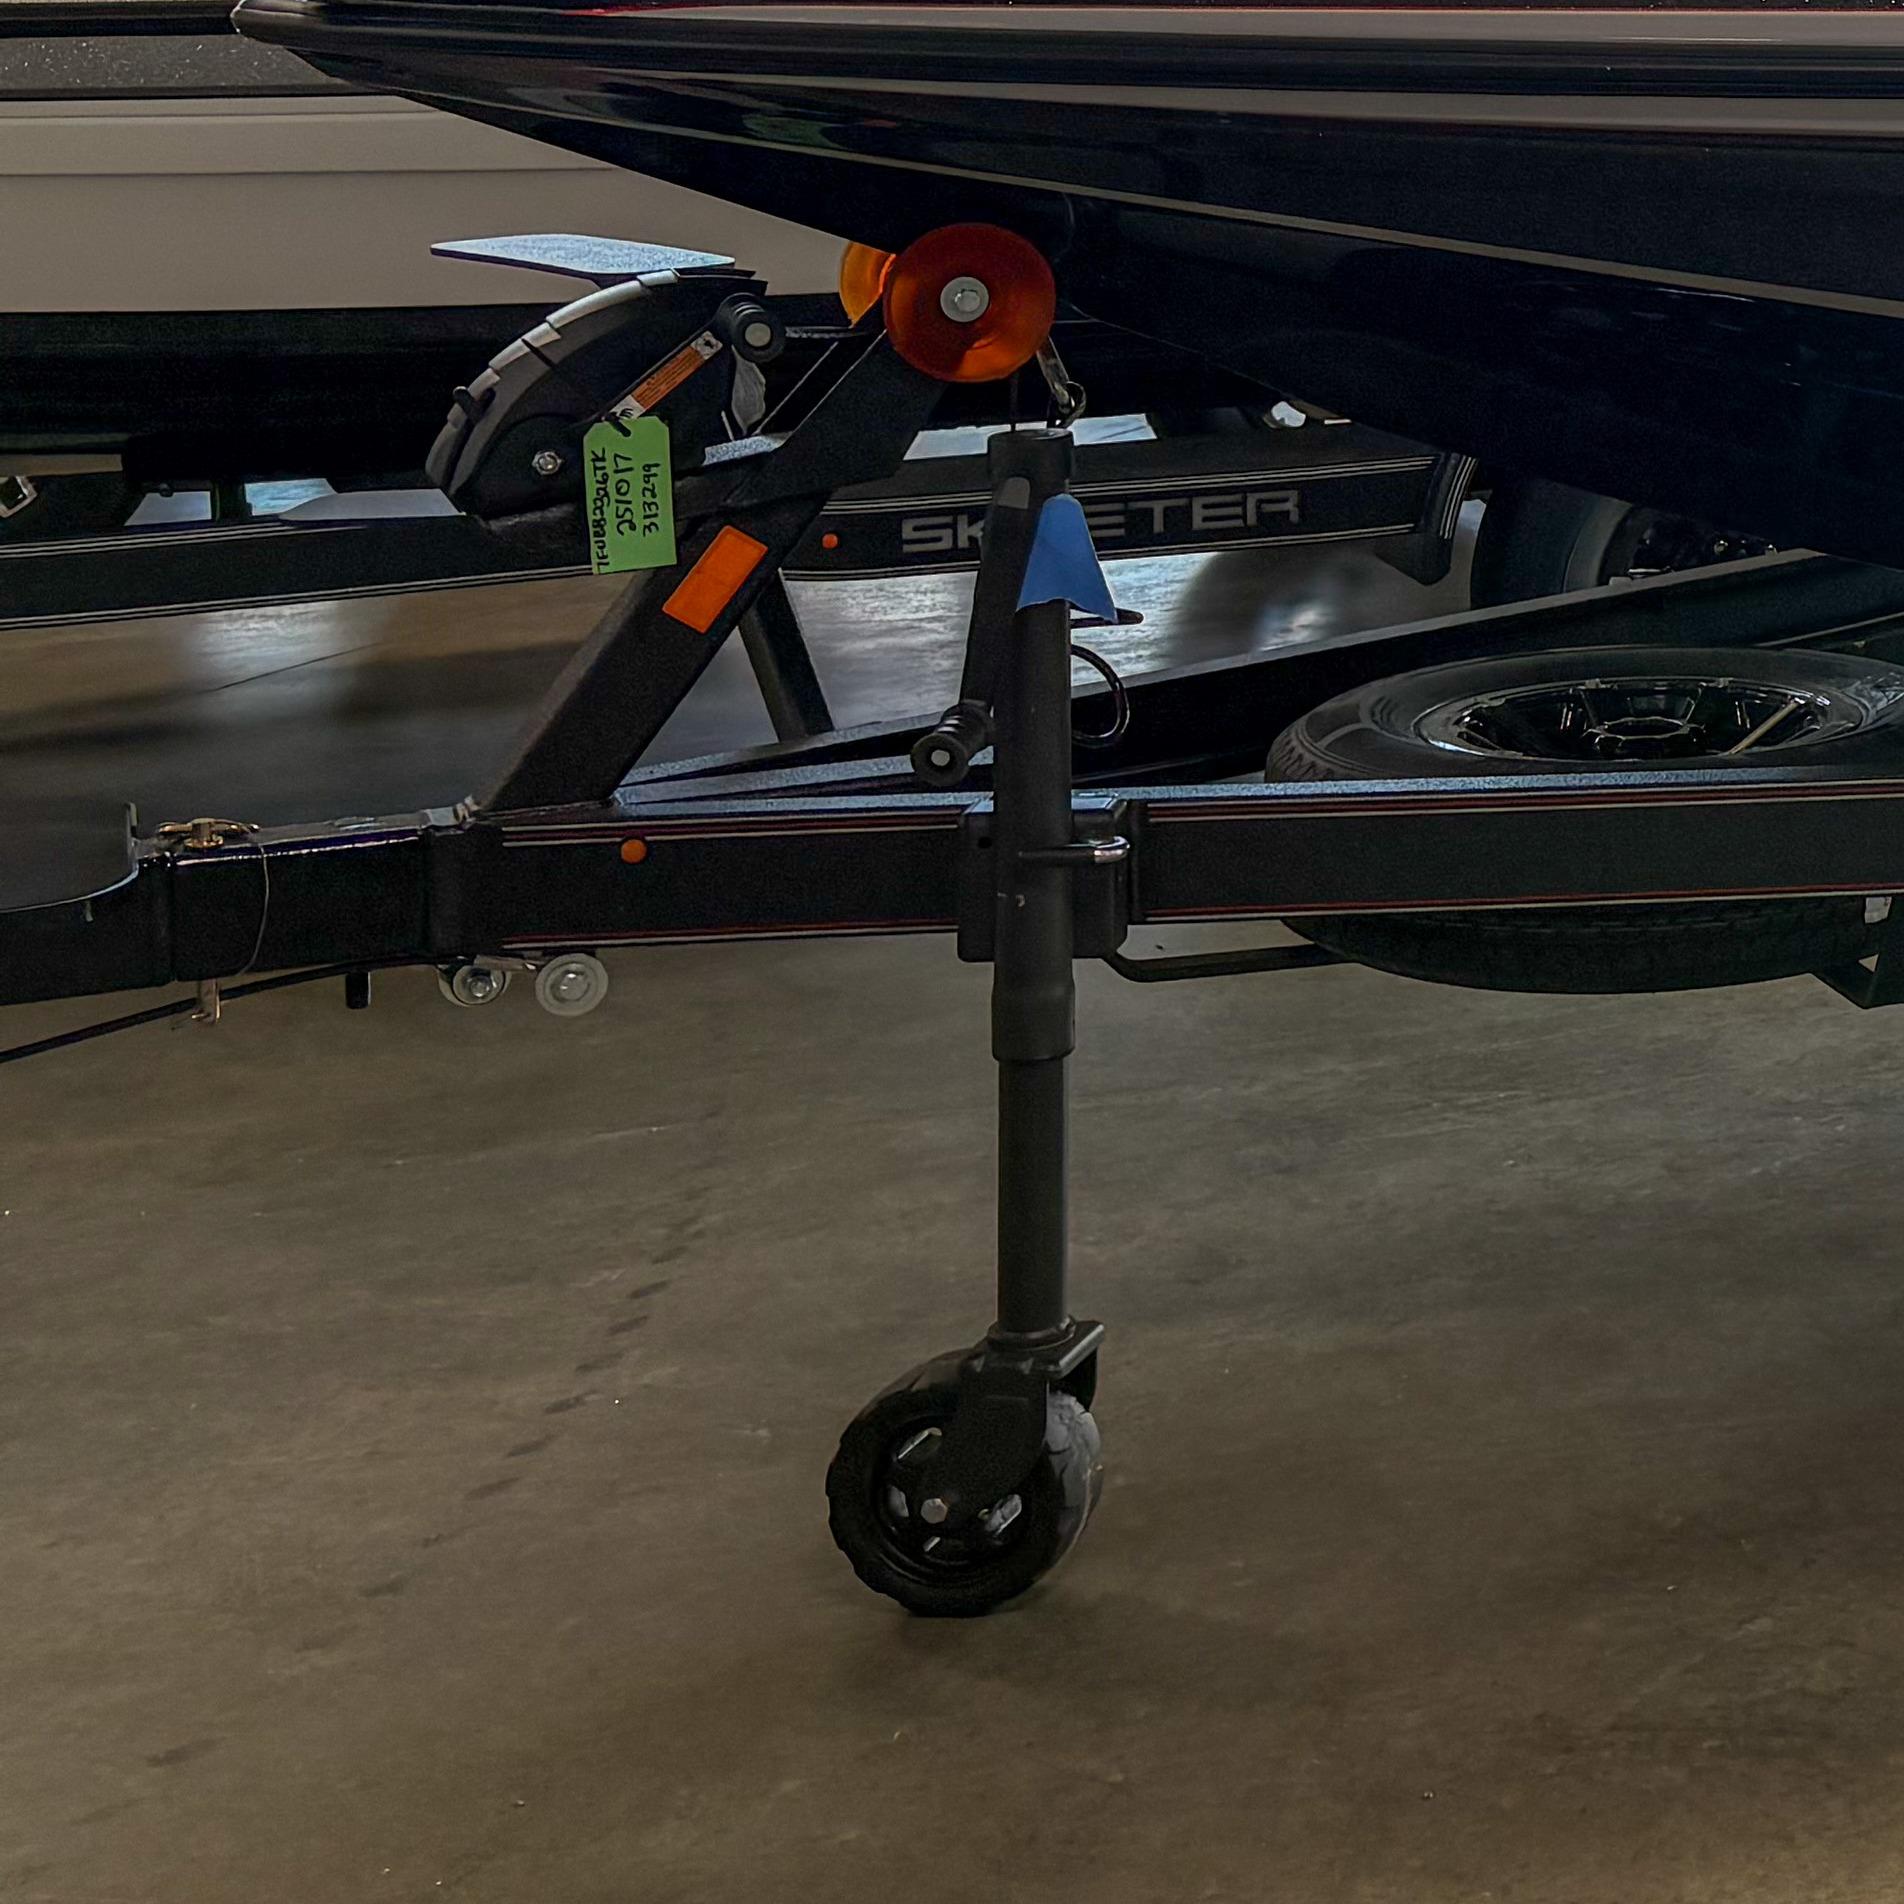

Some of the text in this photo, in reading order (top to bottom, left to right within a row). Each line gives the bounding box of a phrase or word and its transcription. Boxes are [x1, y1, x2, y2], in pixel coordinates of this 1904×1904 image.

[613, 452, 638, 537] 251017
[641, 462, 662, 538] 313299
[902, 489, 1300, 554] SKETER
